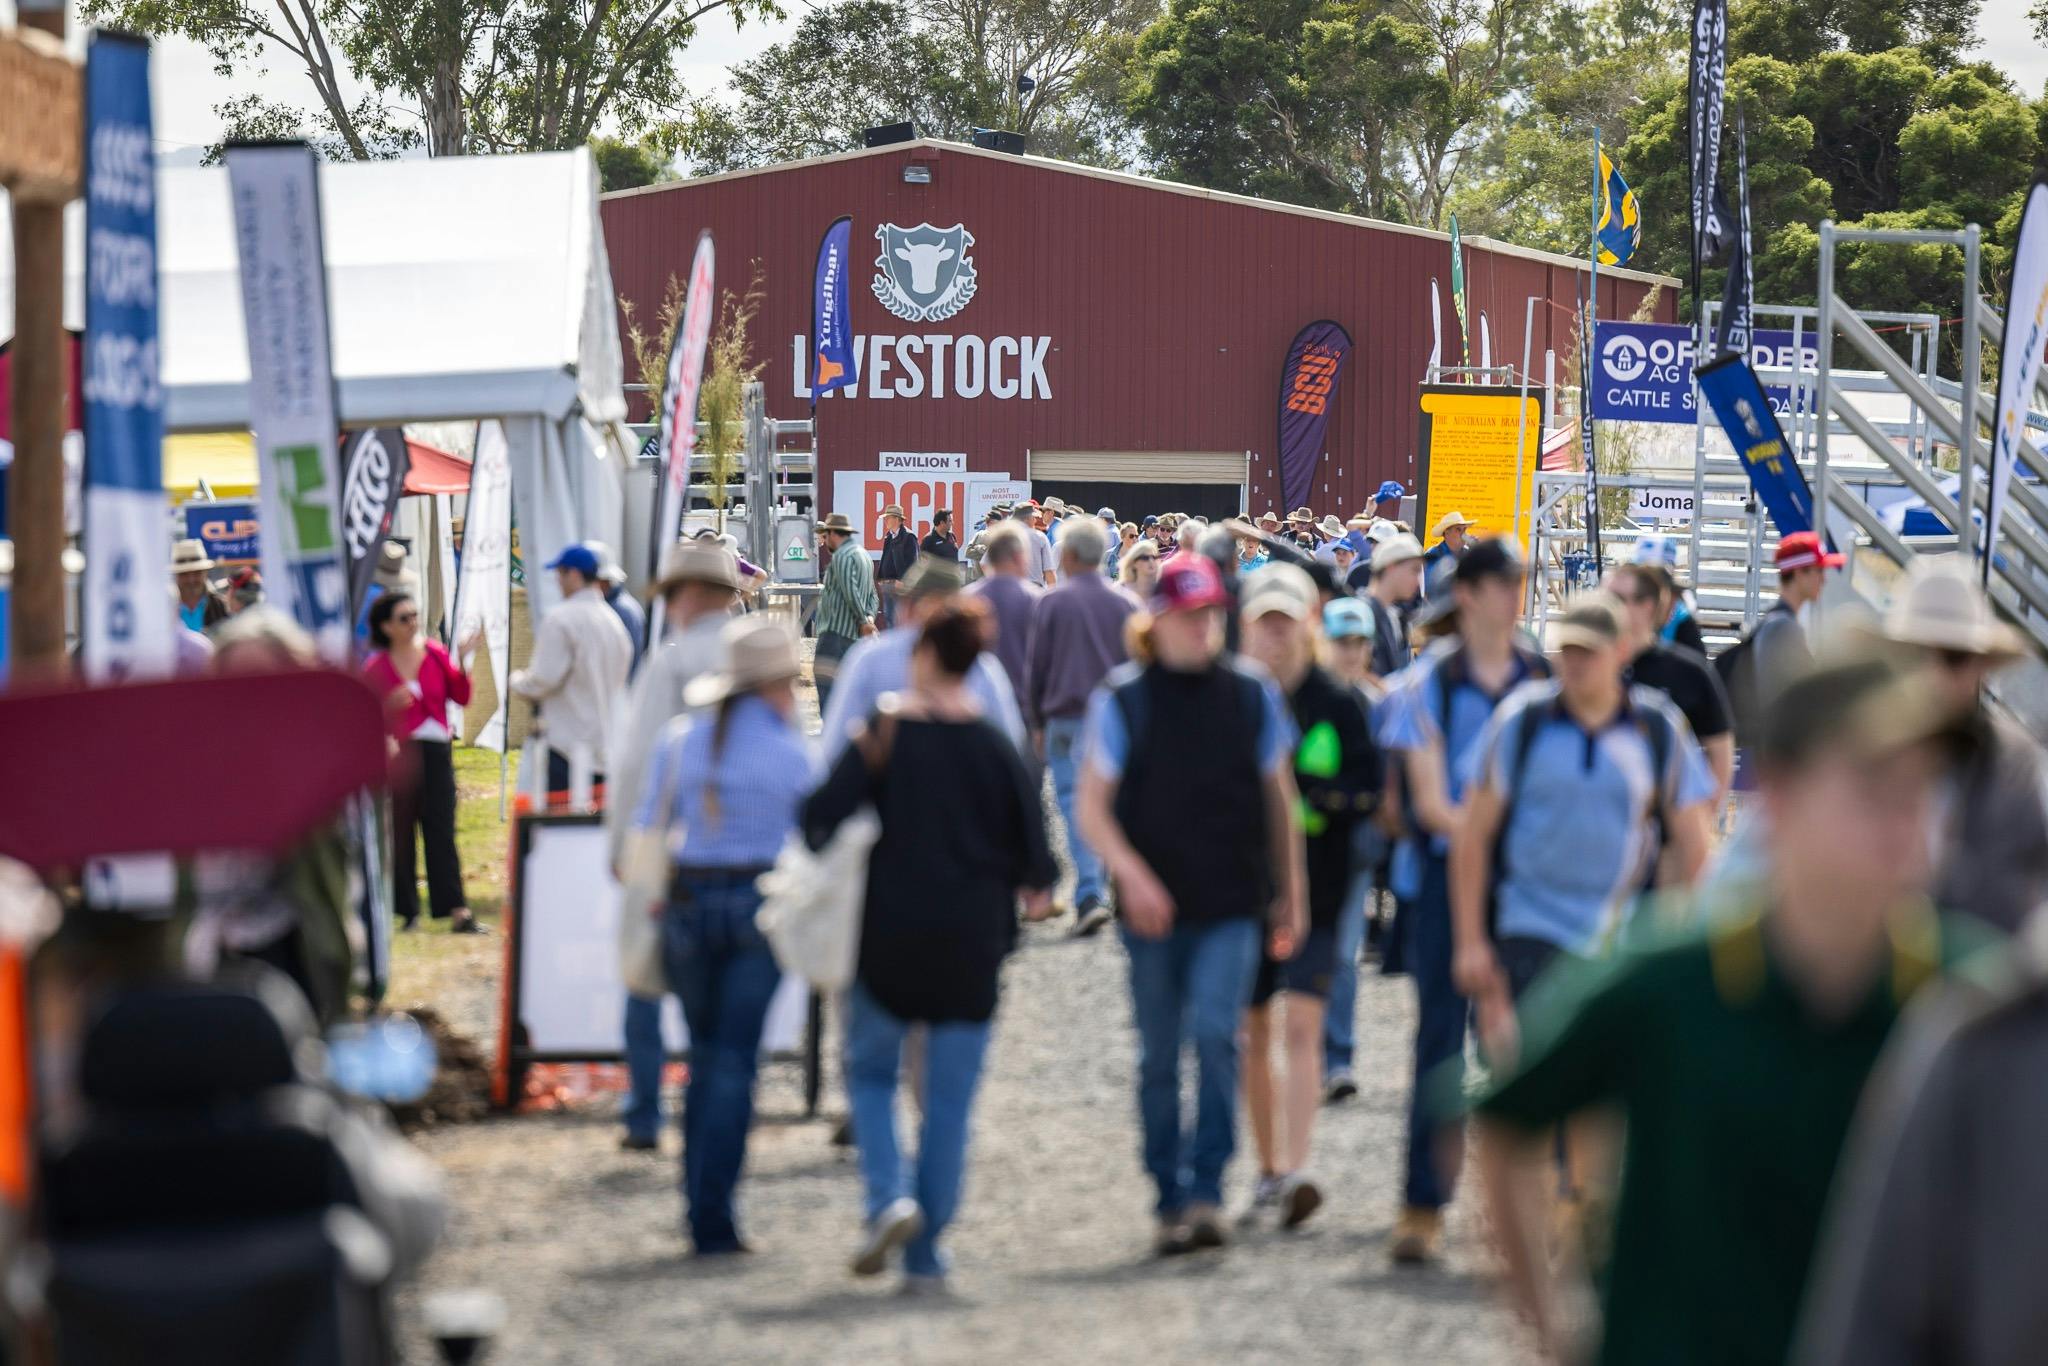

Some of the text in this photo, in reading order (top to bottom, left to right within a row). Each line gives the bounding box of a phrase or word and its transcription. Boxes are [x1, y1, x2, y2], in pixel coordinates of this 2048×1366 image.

[820, 243, 838, 350] Yulgilbar
[1649, 338, 1819, 371] OFFDER
[793, 334, 1053, 400] LVESTOCK
[1648, 365, 1680, 384] AG
[1287, 354, 1338, 415] BCU
[1607, 388, 1671, 408] CATTLE
[1434, 415, 1537, 429] THE AUSTRALIAN BRAHAN
[885, 456, 961, 468] PAVILION 1
[1639, 492, 1694, 510] Joma
[201, 520, 258, 541] CLIP
[787, 546, 804, 557] CRT
